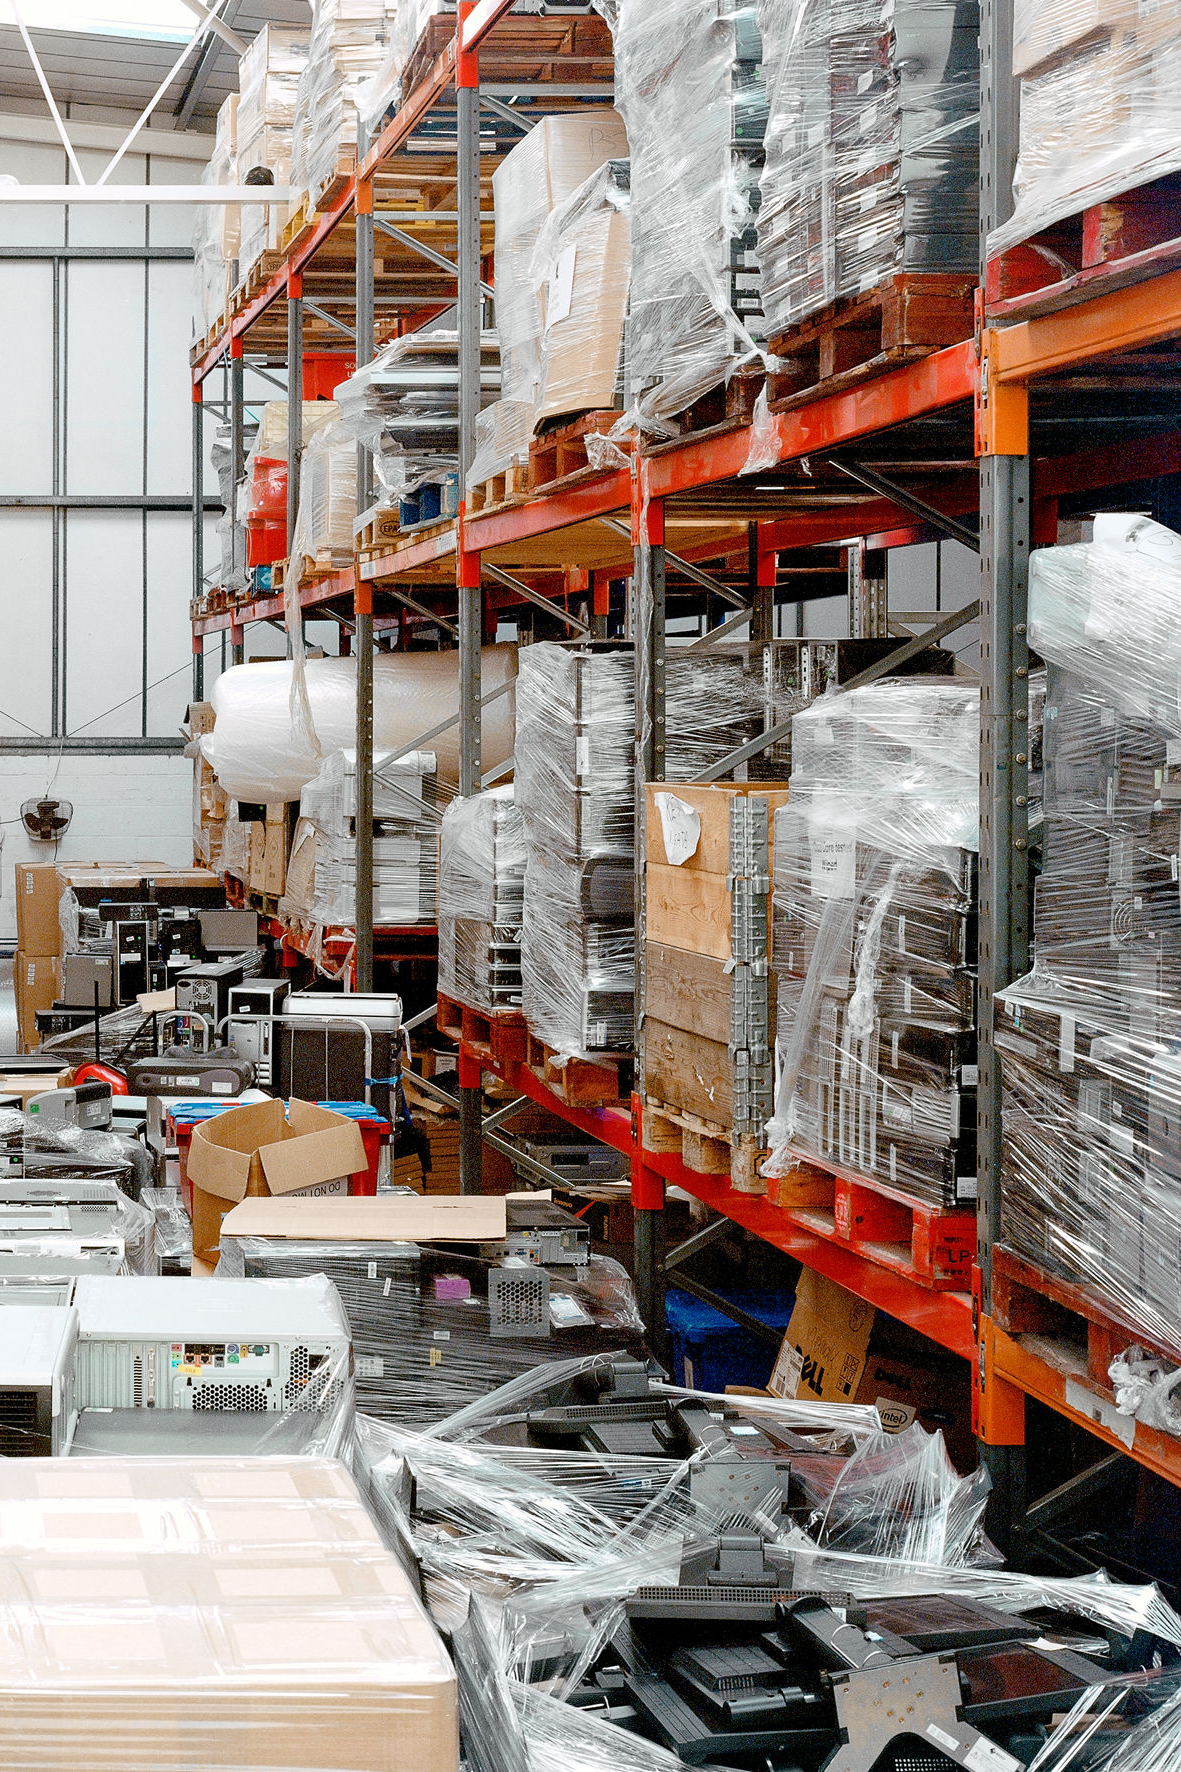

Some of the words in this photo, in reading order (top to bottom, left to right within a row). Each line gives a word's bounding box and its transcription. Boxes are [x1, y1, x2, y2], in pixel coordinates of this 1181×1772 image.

[328, 1181, 341, 1193] DO
[948, 1249, 972, 1263] LP
[880, 1410, 905, 1424] intel
